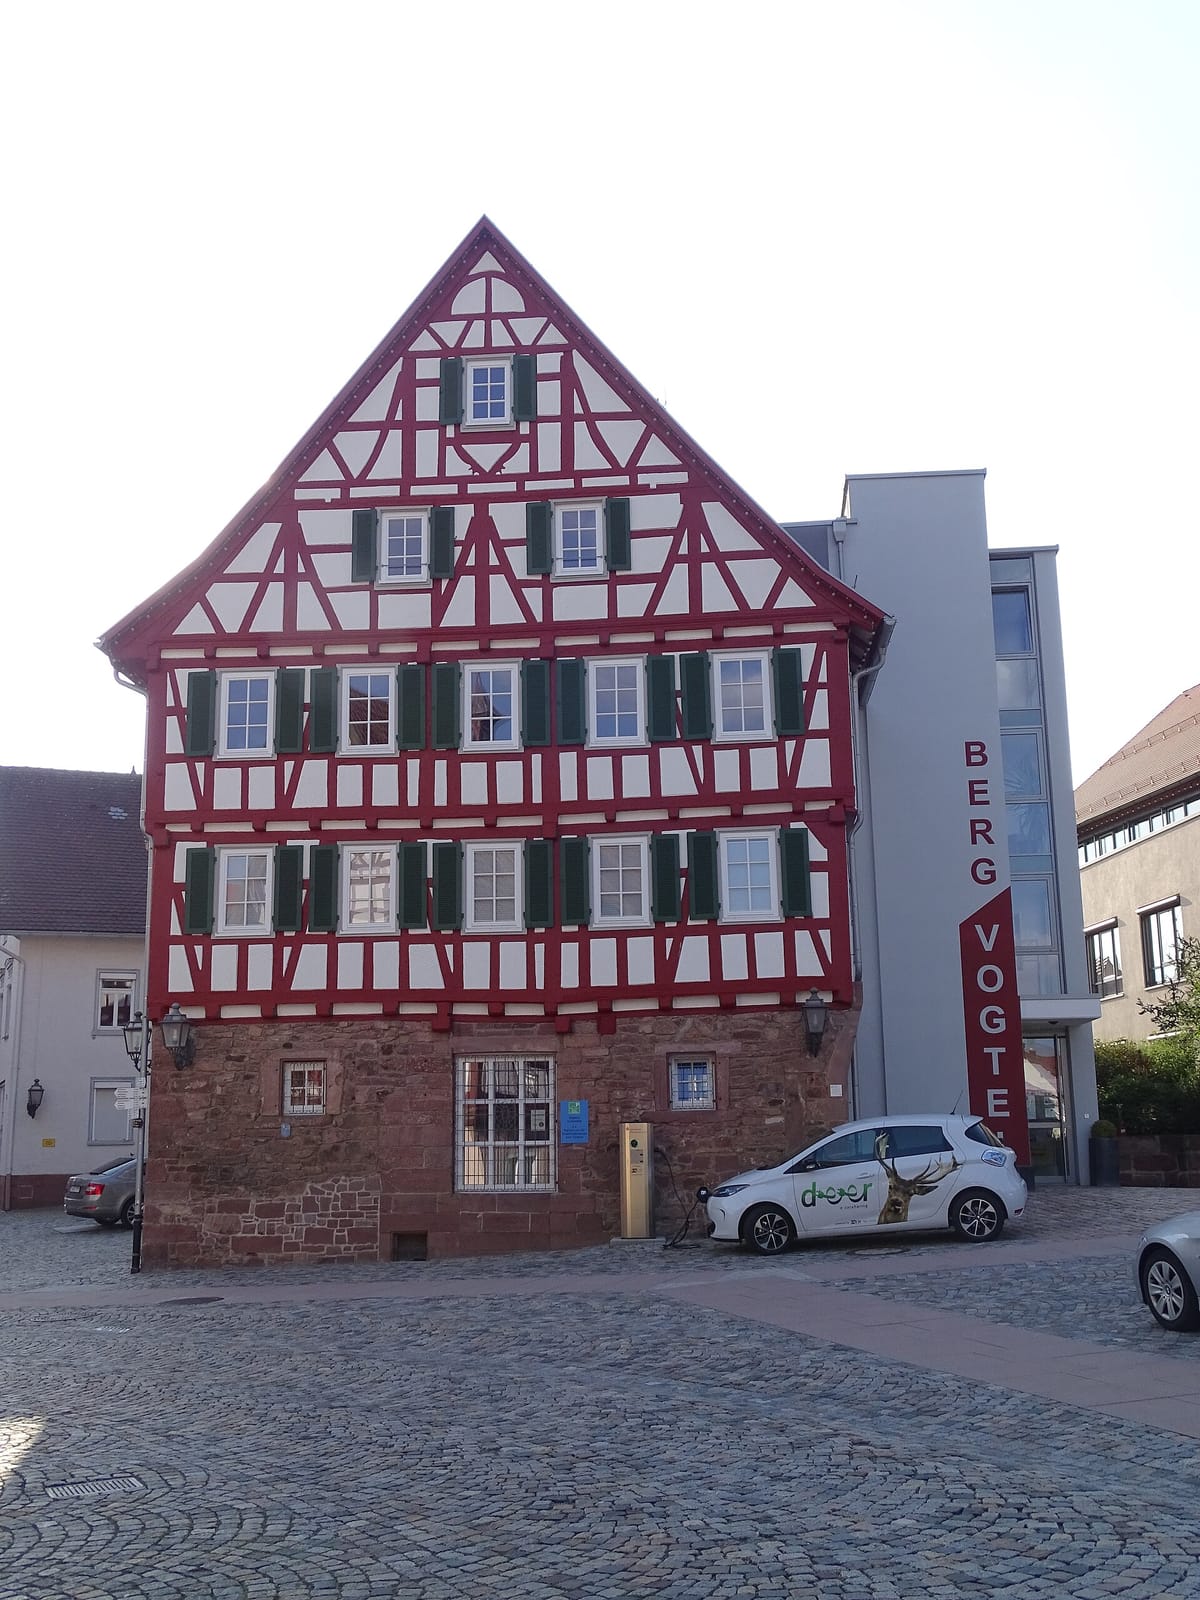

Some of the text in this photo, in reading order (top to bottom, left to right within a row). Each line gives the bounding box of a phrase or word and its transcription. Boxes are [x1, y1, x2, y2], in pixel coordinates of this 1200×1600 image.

[964, 741, 1010, 1139] BERG VOGTE
[801, 1182, 873, 1207] deer
